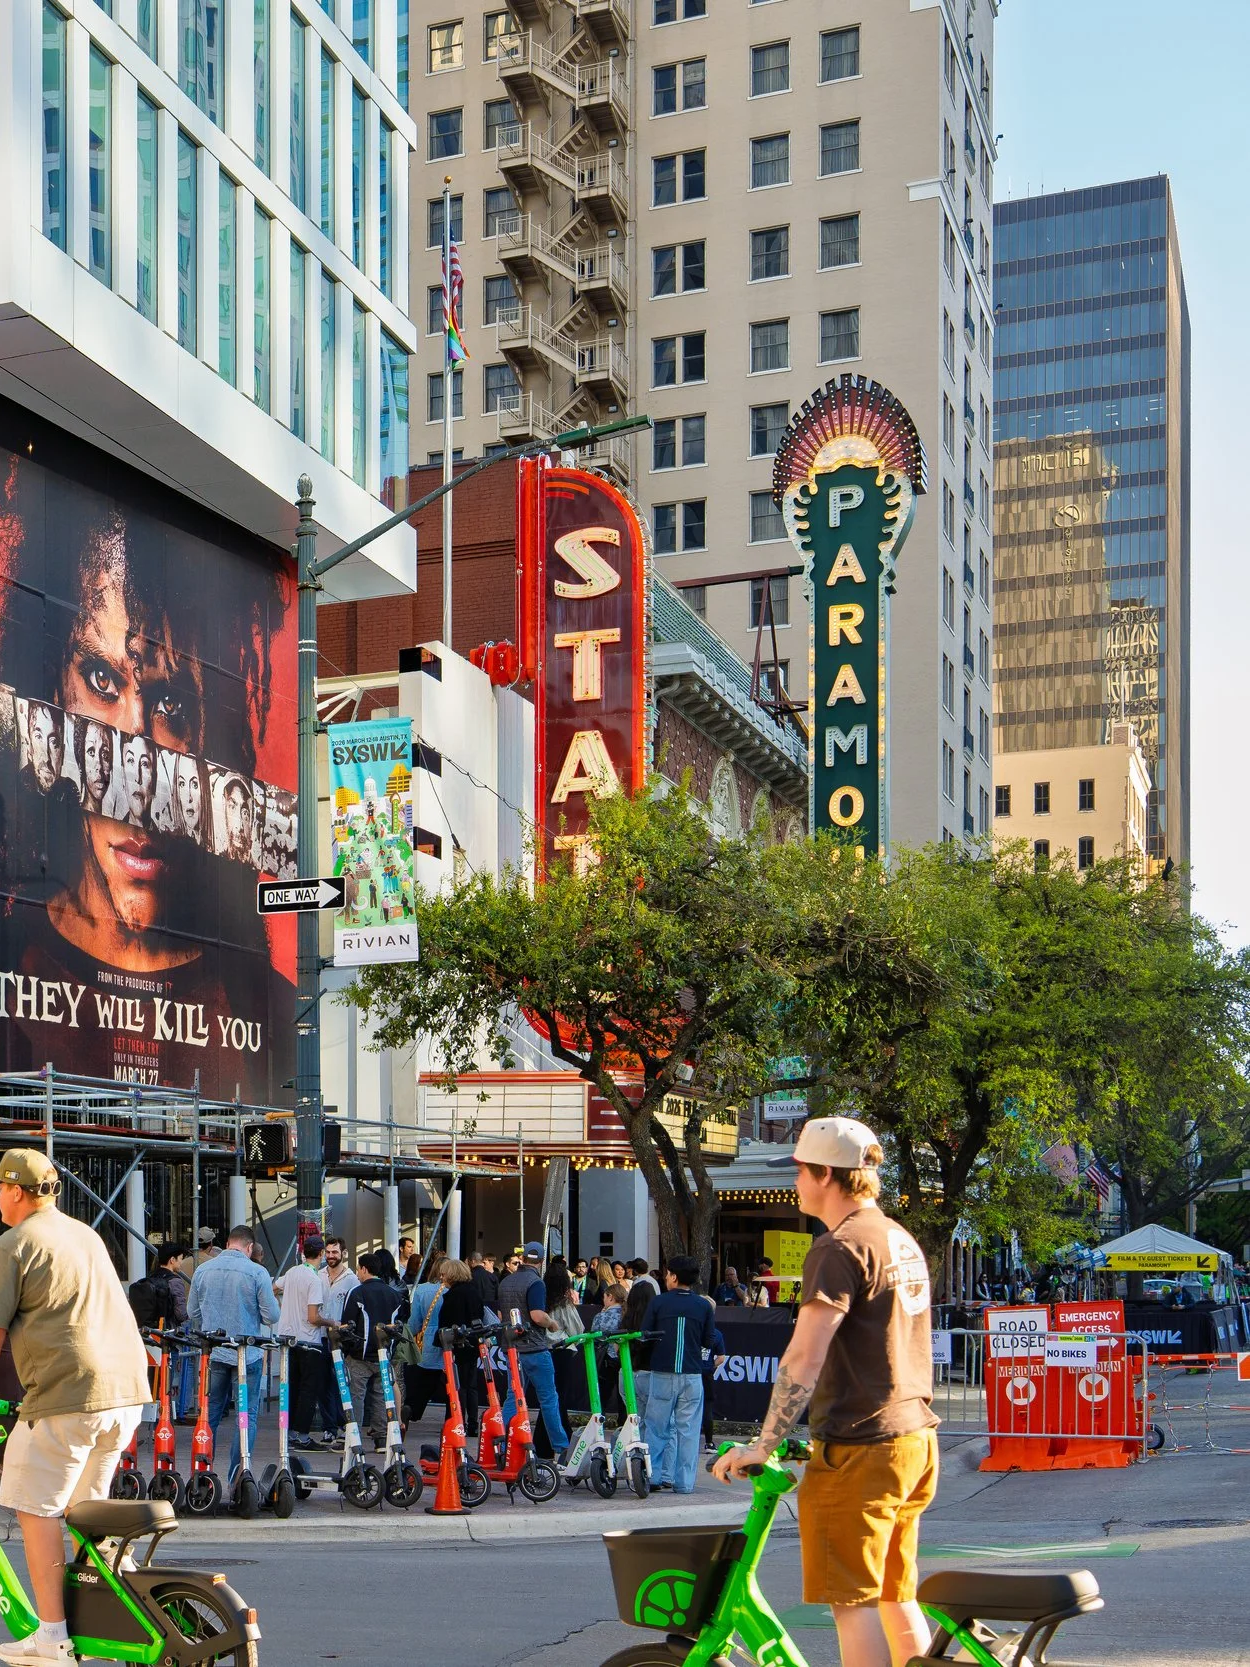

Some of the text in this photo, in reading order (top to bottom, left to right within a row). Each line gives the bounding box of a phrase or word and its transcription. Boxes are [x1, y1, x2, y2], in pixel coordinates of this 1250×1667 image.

[825, 484, 868, 872] PARAMO
[551, 526, 623, 890] STAT
[346, 737, 365, 745] MARCH
[379, 734, 400, 742] AUSTIN,
[267, 888, 319, 904] ONE WAY
[343, 934, 410, 949] RIVIAN
[97, 971, 112, 983] FROM
[114, 974, 124, 986] THE
[125, 977, 155, 992] PRODUCERS
[157, 982, 163, 993] OF
[94, 993, 145, 1033] WILL
[153, 997, 209, 1047] KILL
[217, 1015, 262, 1052] YOU
[114, 1037, 125, 1050] LET
[128, 1039, 145, 1054] THEM
[114, 1052, 159, 1067] ONLY IN THEATERS
[1059, 1310, 1120, 1323] EMERGENCY
[999, 1320, 1038, 1332] ROAD
[1071, 1325, 1111, 1333] ACCESS
[992, 1336, 1046, 1349] CLOSED
[1047, 1349, 1087, 1359] NO BIKES
[713, 1356, 769, 1382] XSW
[998, 1365, 1047, 1377] MERIDIAN
[570, 1440, 587, 1466] Lime
[613, 1441, 624, 1465] ime
